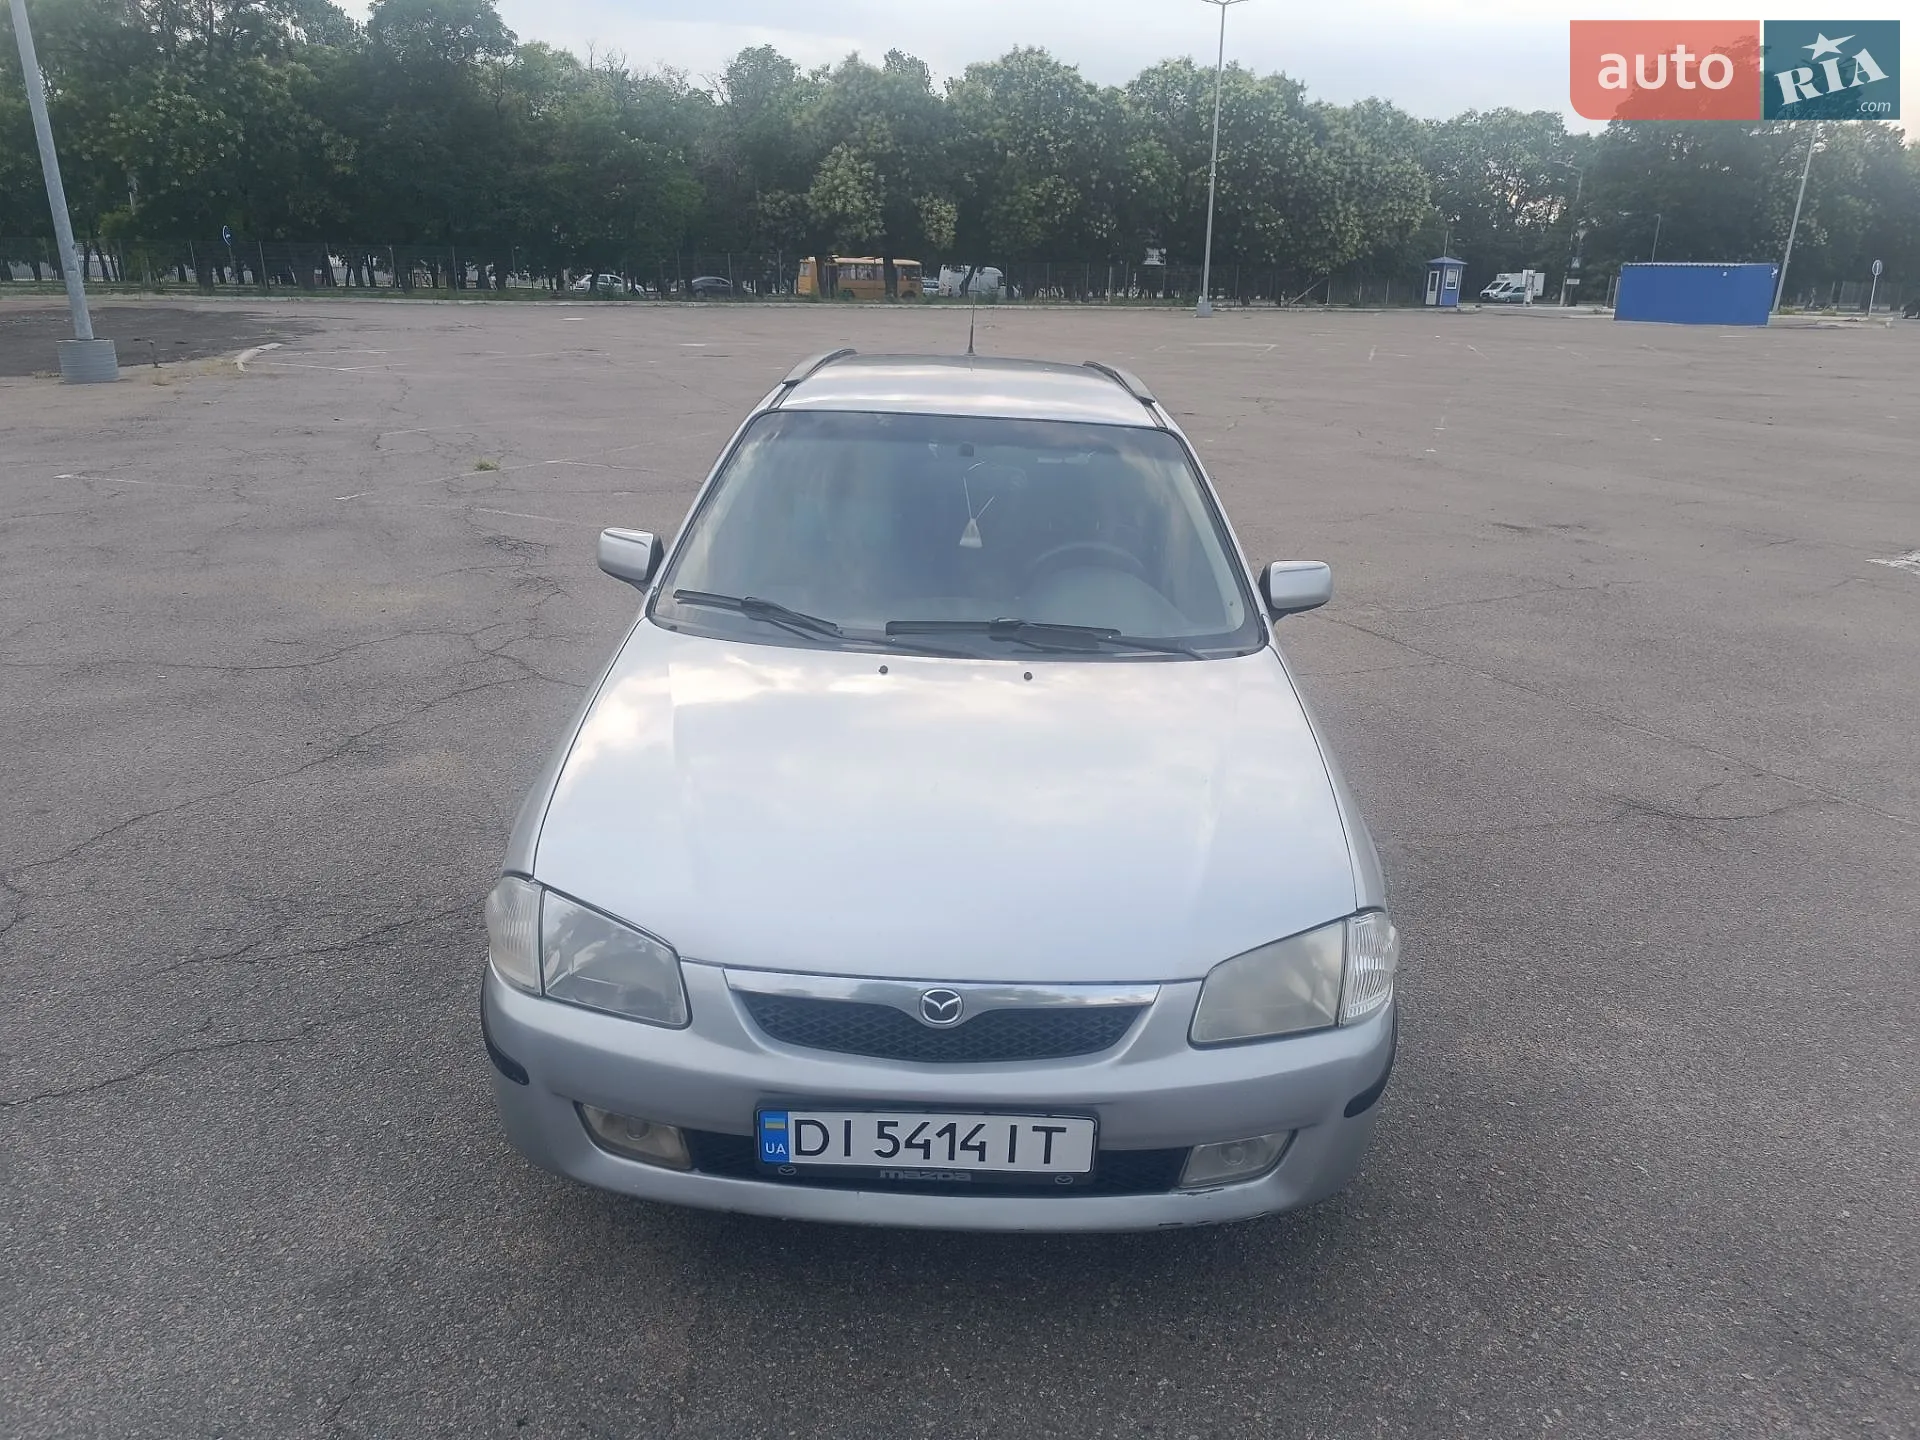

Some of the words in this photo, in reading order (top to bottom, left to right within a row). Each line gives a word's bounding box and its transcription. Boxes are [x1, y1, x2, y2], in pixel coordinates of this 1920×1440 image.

[765, 1142, 786, 1155] UA
[795, 1119, 852, 1157] DI
[873, 1121, 987, 1162] 5414
[1007, 1124, 1067, 1165] IT
